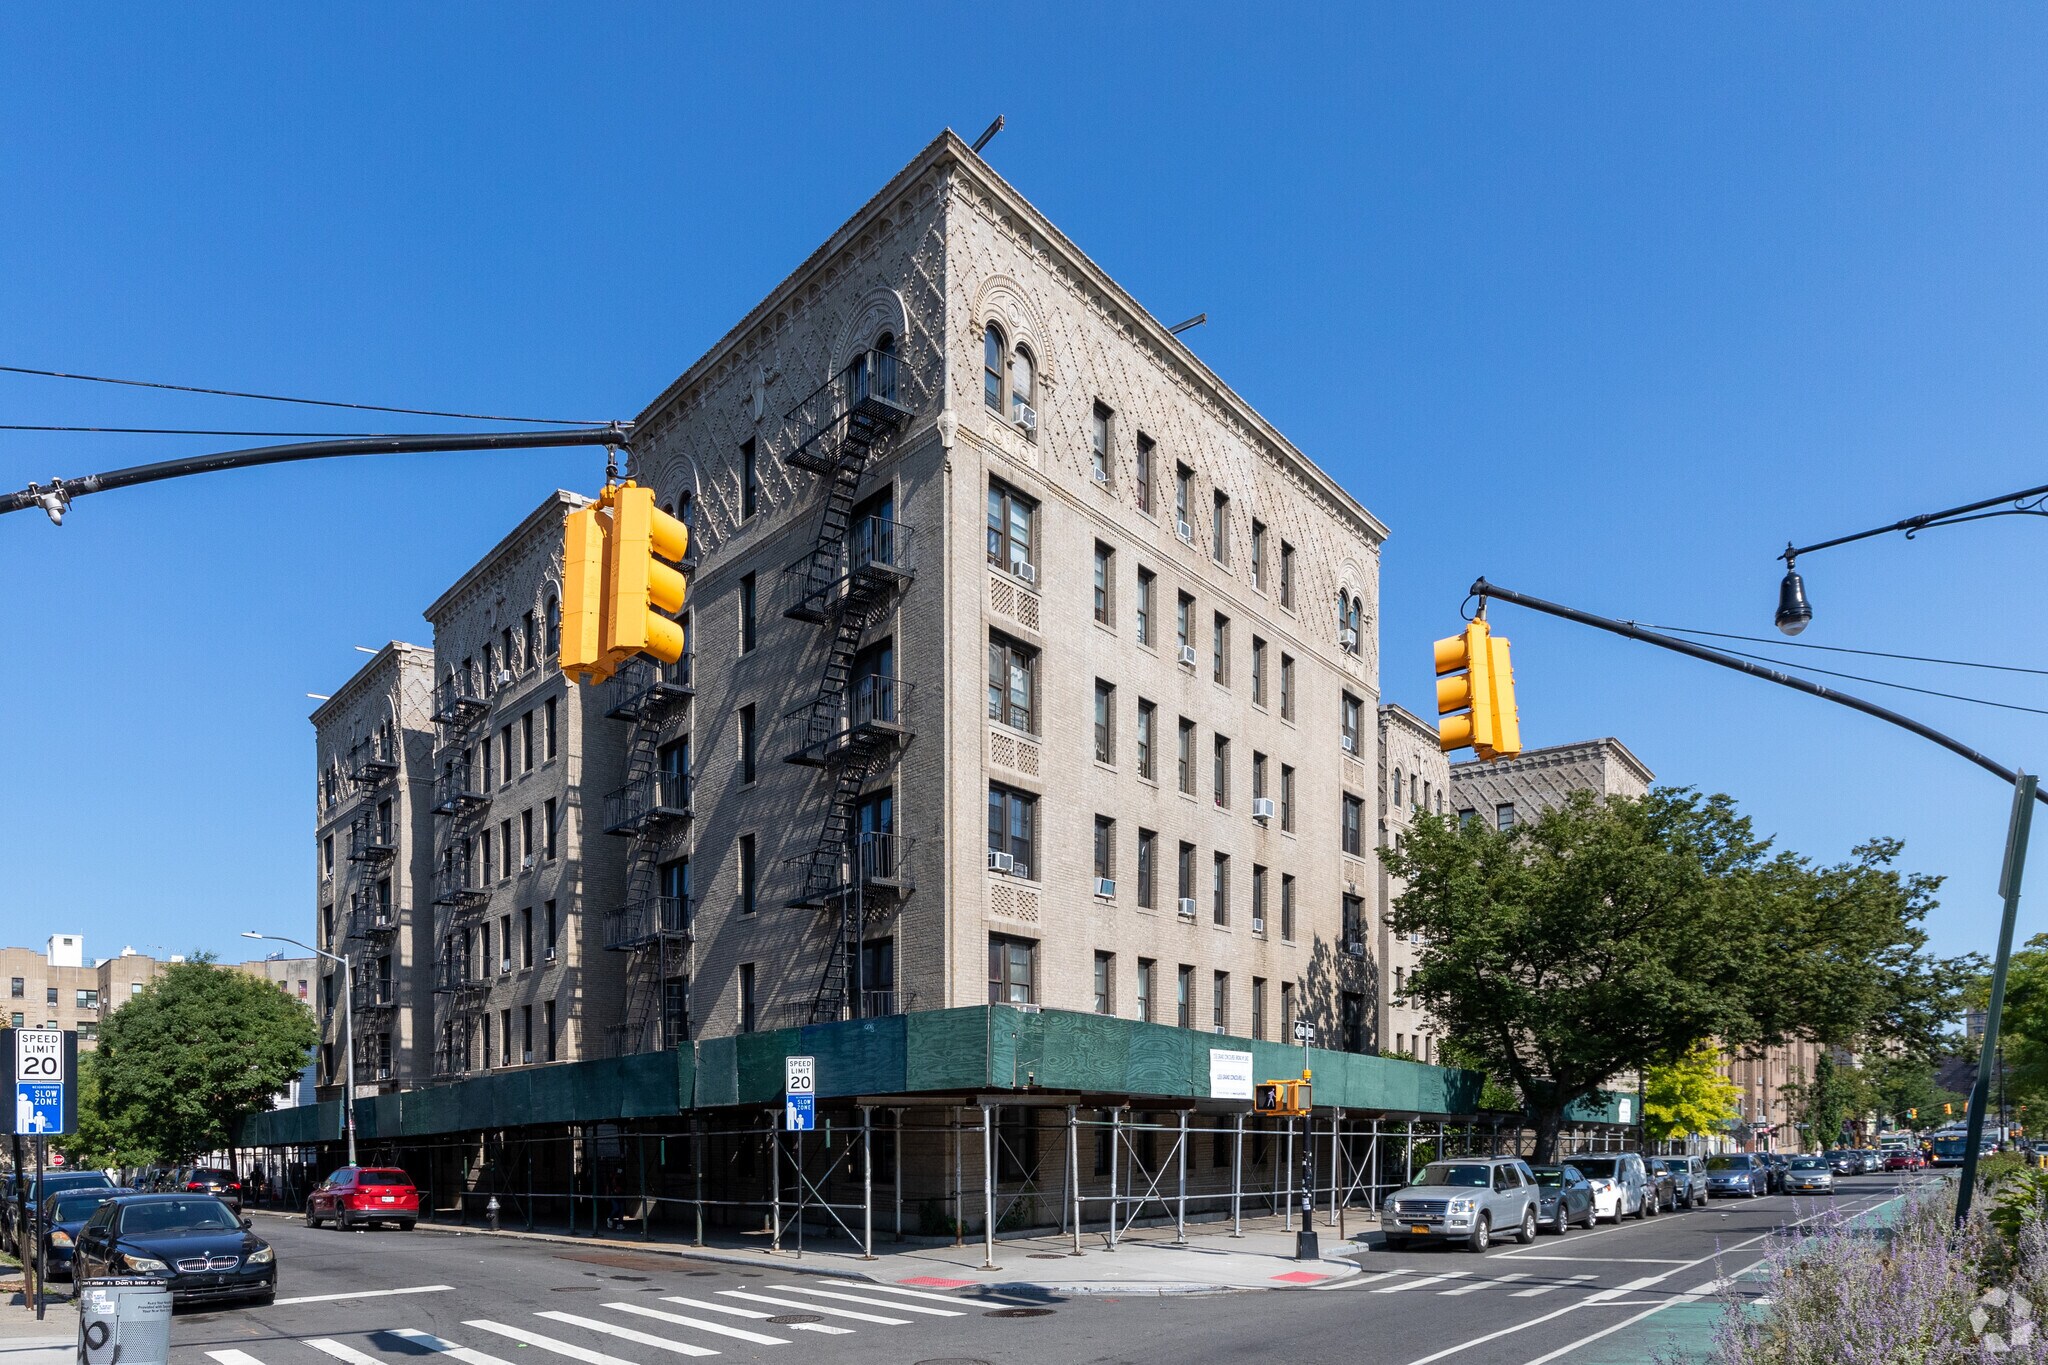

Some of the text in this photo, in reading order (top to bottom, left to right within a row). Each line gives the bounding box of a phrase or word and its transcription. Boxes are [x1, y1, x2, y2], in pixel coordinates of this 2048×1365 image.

[22, 1034, 58, 1043] SPEED
[25, 1045, 55, 1053] LIMIT
[24, 1057, 57, 1074] 20
[791, 1076, 811, 1089] 20
